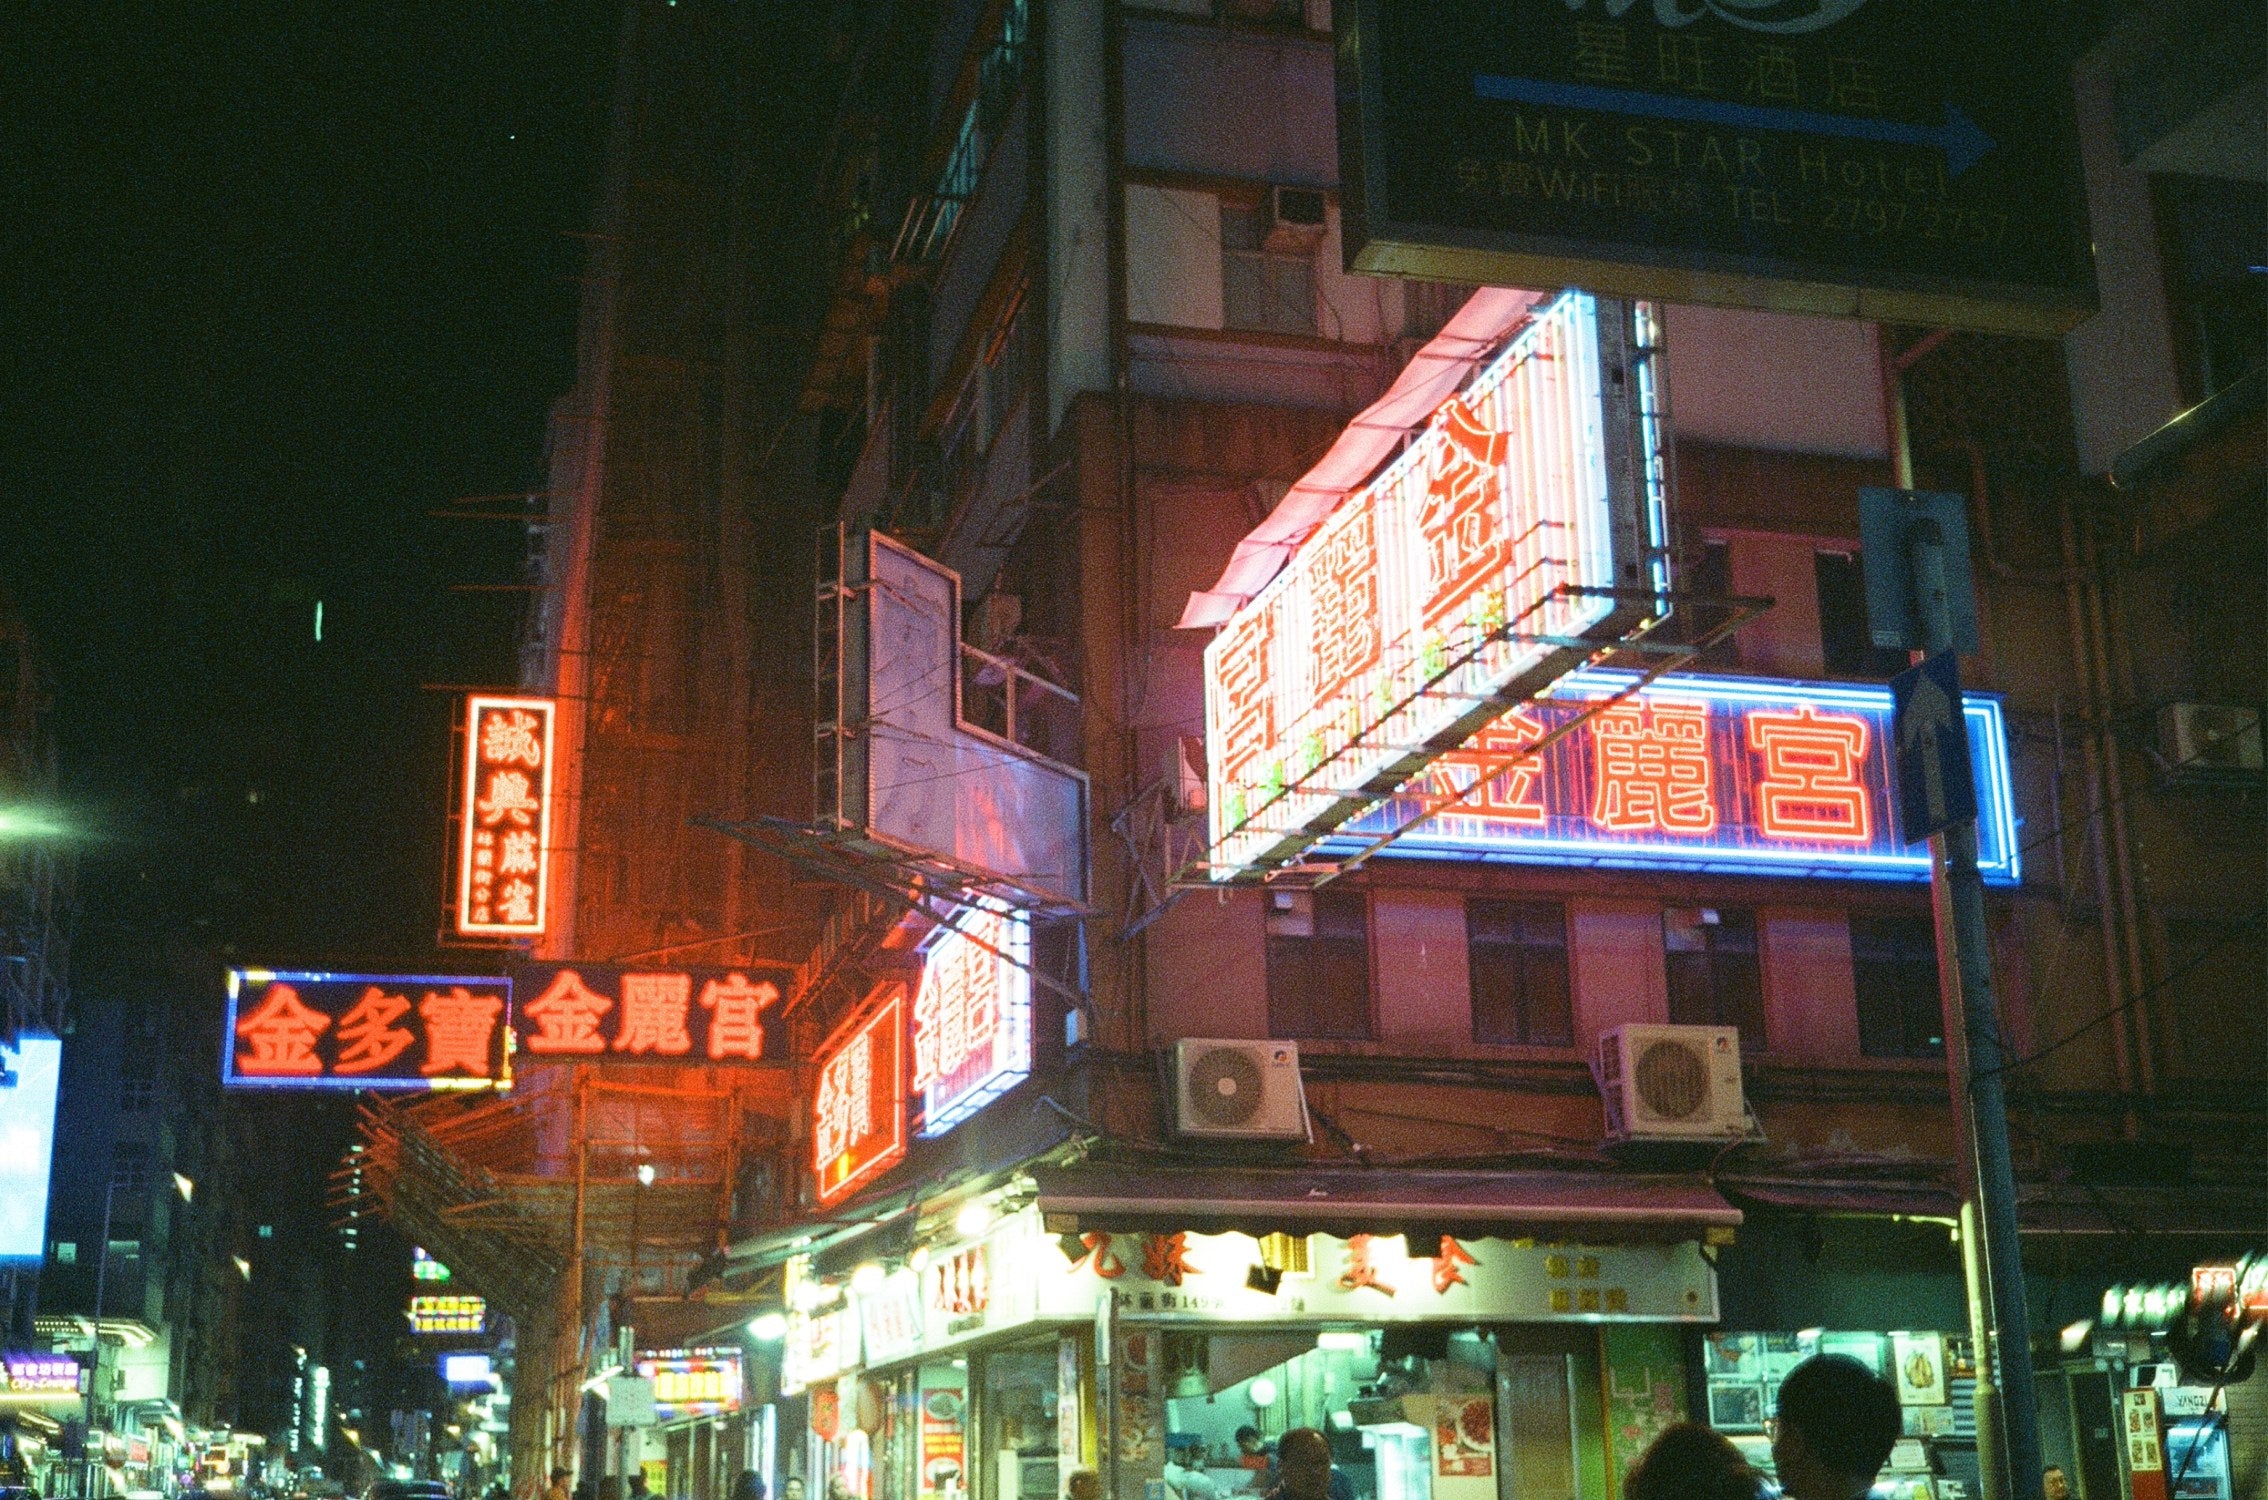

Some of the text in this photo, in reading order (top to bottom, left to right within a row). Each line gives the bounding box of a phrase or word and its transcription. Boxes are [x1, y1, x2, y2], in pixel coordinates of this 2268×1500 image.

[1573, 22, 1882, 111] 星旺酒店
[1513, 114, 1949, 198] MK STAR Hotel
[1728, 185, 1791, 223] TEL
[477, 710, 538, 923] 誠興麻雀
[237, 984, 502, 1076] 金多寶
[524, 969, 779, 1060] 金麗宮
